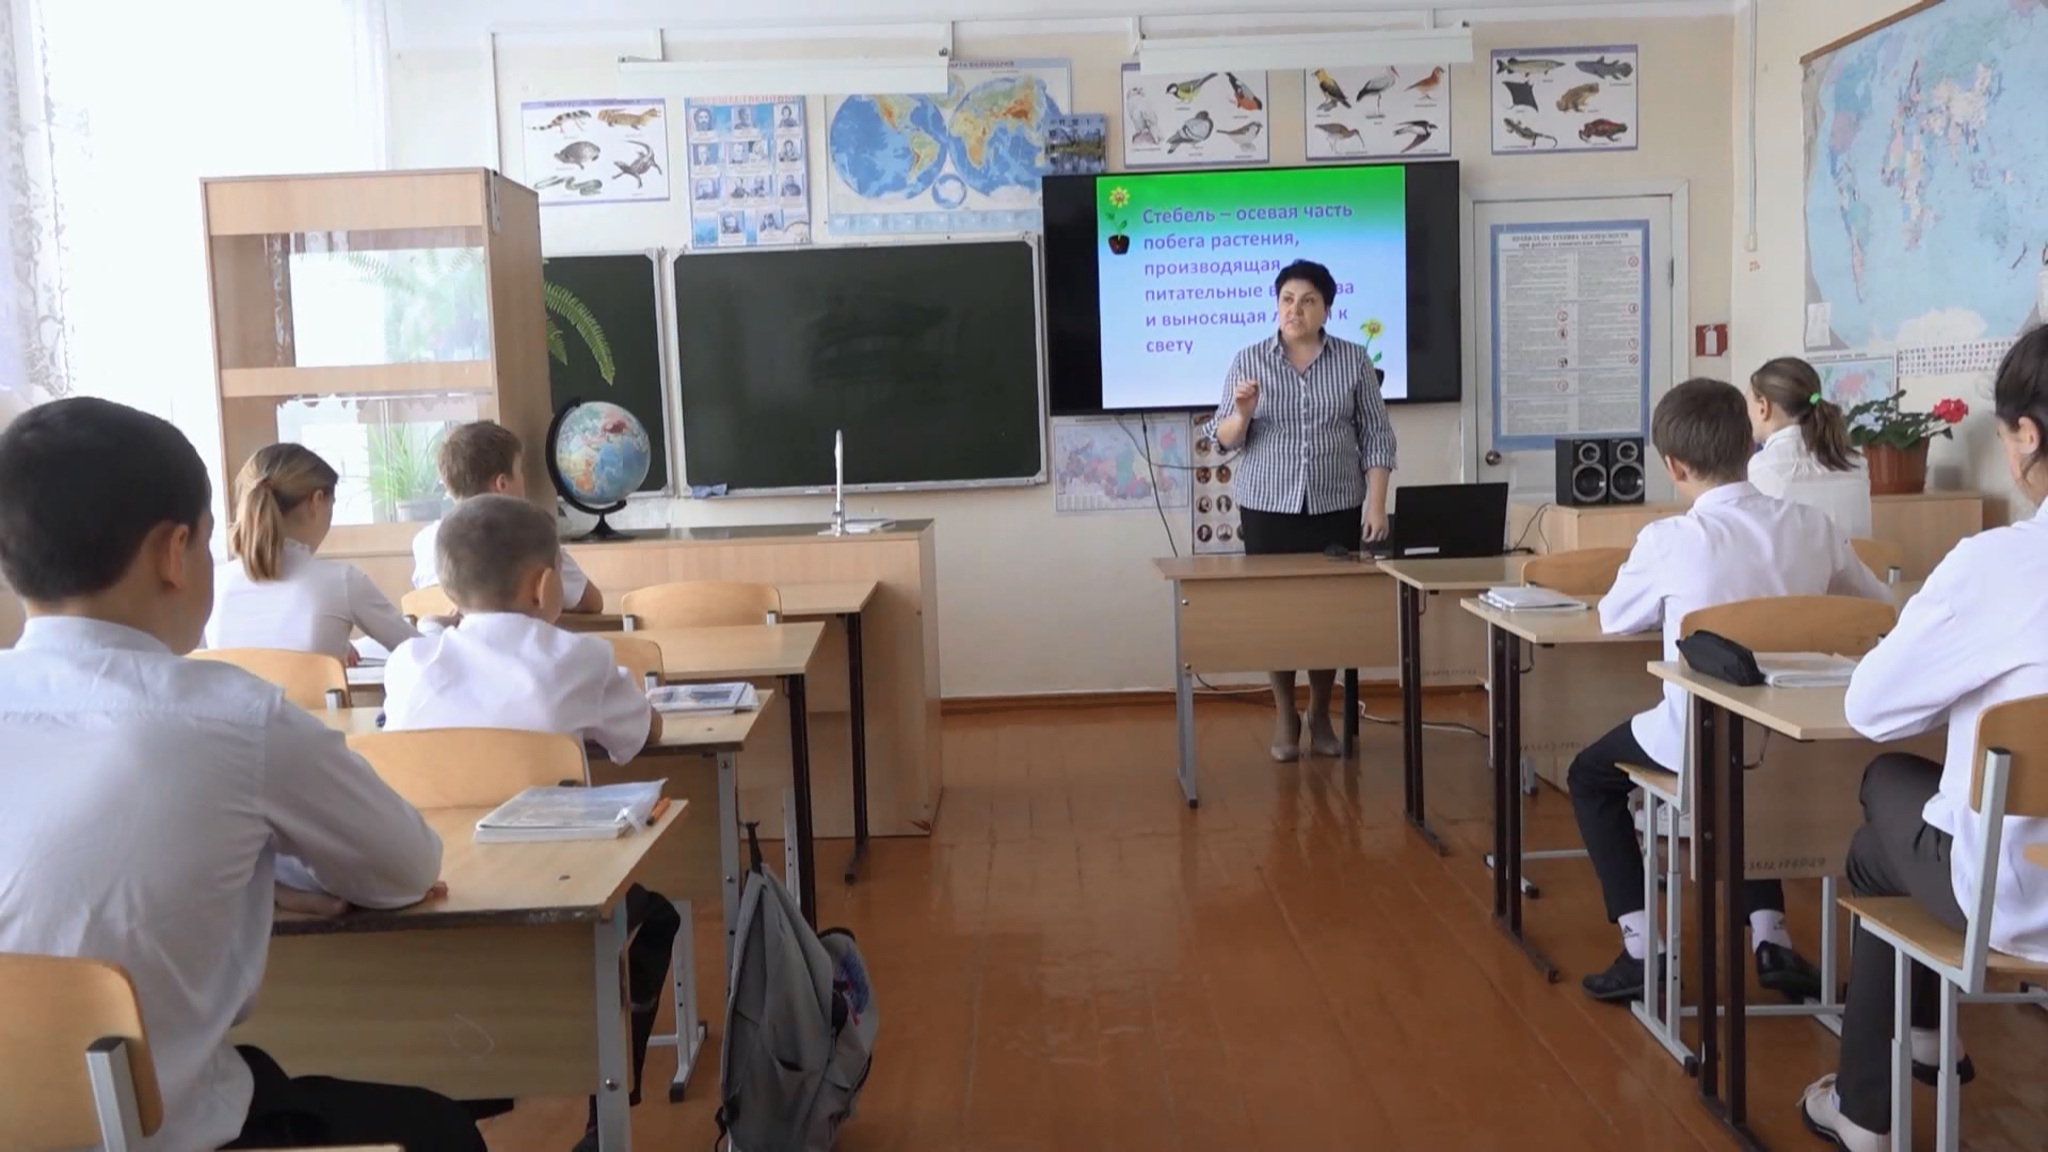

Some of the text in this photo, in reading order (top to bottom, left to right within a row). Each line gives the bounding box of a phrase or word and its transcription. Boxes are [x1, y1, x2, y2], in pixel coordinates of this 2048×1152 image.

[1143, 207, 1215, 225] Стебель
[1236, 206, 1298, 221] осевая
[1303, 204, 1353, 219] часть
[1143, 232, 1299, 251] побега растения,
[1144, 259, 1281, 278] производящая
[1144, 286, 1263, 302] питательные
[1146, 314, 1156, 327] и
[1161, 311, 1266, 328] выносящая
[1339, 308, 1348, 320] к
[1146, 339, 1194, 356] свету
